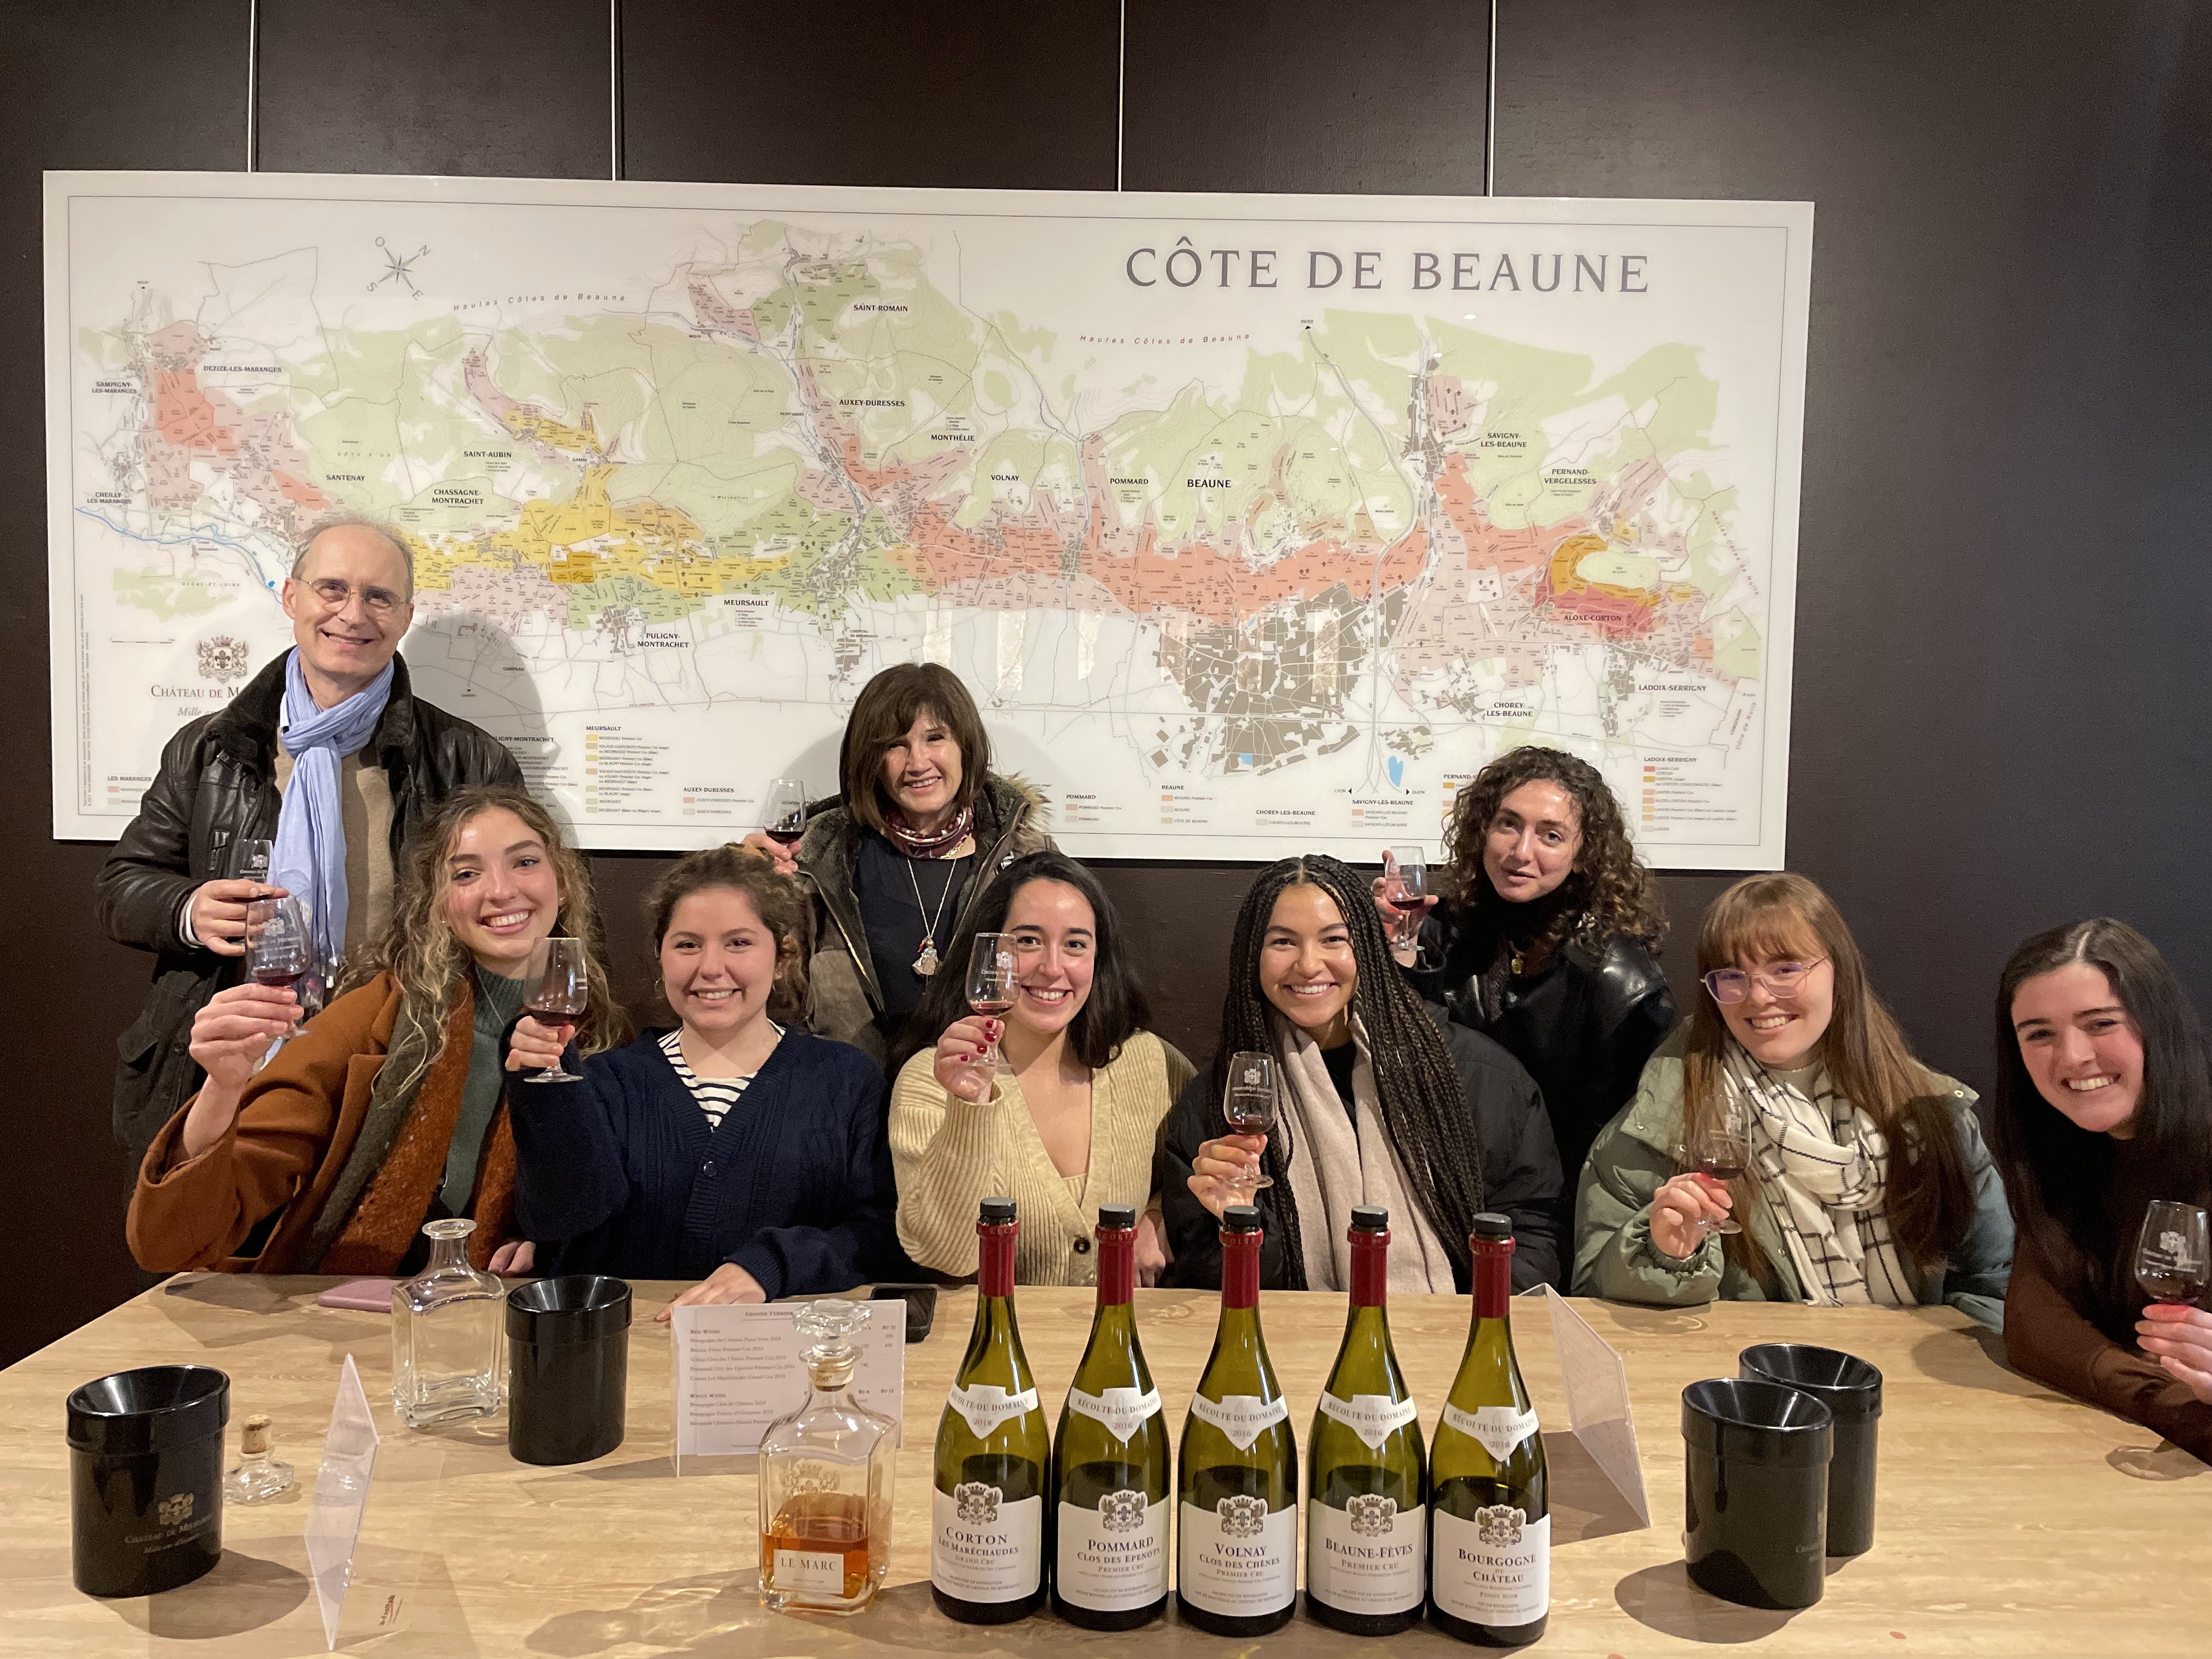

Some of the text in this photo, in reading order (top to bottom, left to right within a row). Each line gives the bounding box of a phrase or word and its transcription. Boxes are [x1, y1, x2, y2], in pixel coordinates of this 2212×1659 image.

[375, 236, 385, 247] O
[1126, 236, 1649, 292] CÔTE DE BEAUNE
[453, 293, 625, 312] Hautes Côtes de Beaune
[1080, 335, 1125, 344] Hautes
[1134, 336, 1171, 345] Côtes
[1204, 334, 1250, 343] Beaune
[839, 399, 905, 407] AUXEY-DURESSES
[931, 433, 975, 442] MONTHÉLIE
[1487, 432, 1522, 440] SAVIGNY-
[991, 474, 1019, 482] VOLNAY
[1187, 479, 1232, 489] BEAUNE
[433, 488, 482, 496] CHASSAGNE-
[1740, 564, 1747, 572] de
[646, 633, 680, 641] PULIGNY-
[151, 685, 204, 697] CHÂTEAU
[210, 689, 223, 698] DE
[1639, 684, 1707, 692] LADOIX-SERRIGNY
[177, 707, 201, 716] Mille
[977, 1403, 989, 1412] DU
[992, 1398, 1029, 1412] DOMAINE
[1077, 1398, 1111, 1414] RÉCOLTE
[1130, 1397, 1158, 1413] DOMAINE
[1249, 1406, 1281, 1421] DOMAINE
[1380, 1406, 1411, 1420] DOMAINE
[1506, 1417, 1535, 1432] DOMAINE
[946, 1526, 1008, 1545] CORTON
[939, 1536, 1019, 1556] LES MARÉCHAUDES
[1088, 1536, 1153, 1553] POMMARD
[1215, 1542, 1267, 1558] VOLNAY
[1325, 1537, 1413, 1559] BEAUNE-FÈVES
[956, 1555, 979, 1565] GRAND
[1077, 1551, 1101, 1563] CLOS
[1125, 1547, 1160, 1562] EPENOTS
[1200, 1553, 1222, 1567] CLOS
[1458, 1548, 1536, 1566] BOURGOGNE
[781, 1557, 836, 1571] LE MARC
[1132, 1563, 1144, 1571] CRU
[1341, 1559, 1380, 1571] PREMIER
[1217, 1568, 1248, 1577] PREMIER
[1473, 1570, 1523, 1583] CHÂTEAU
